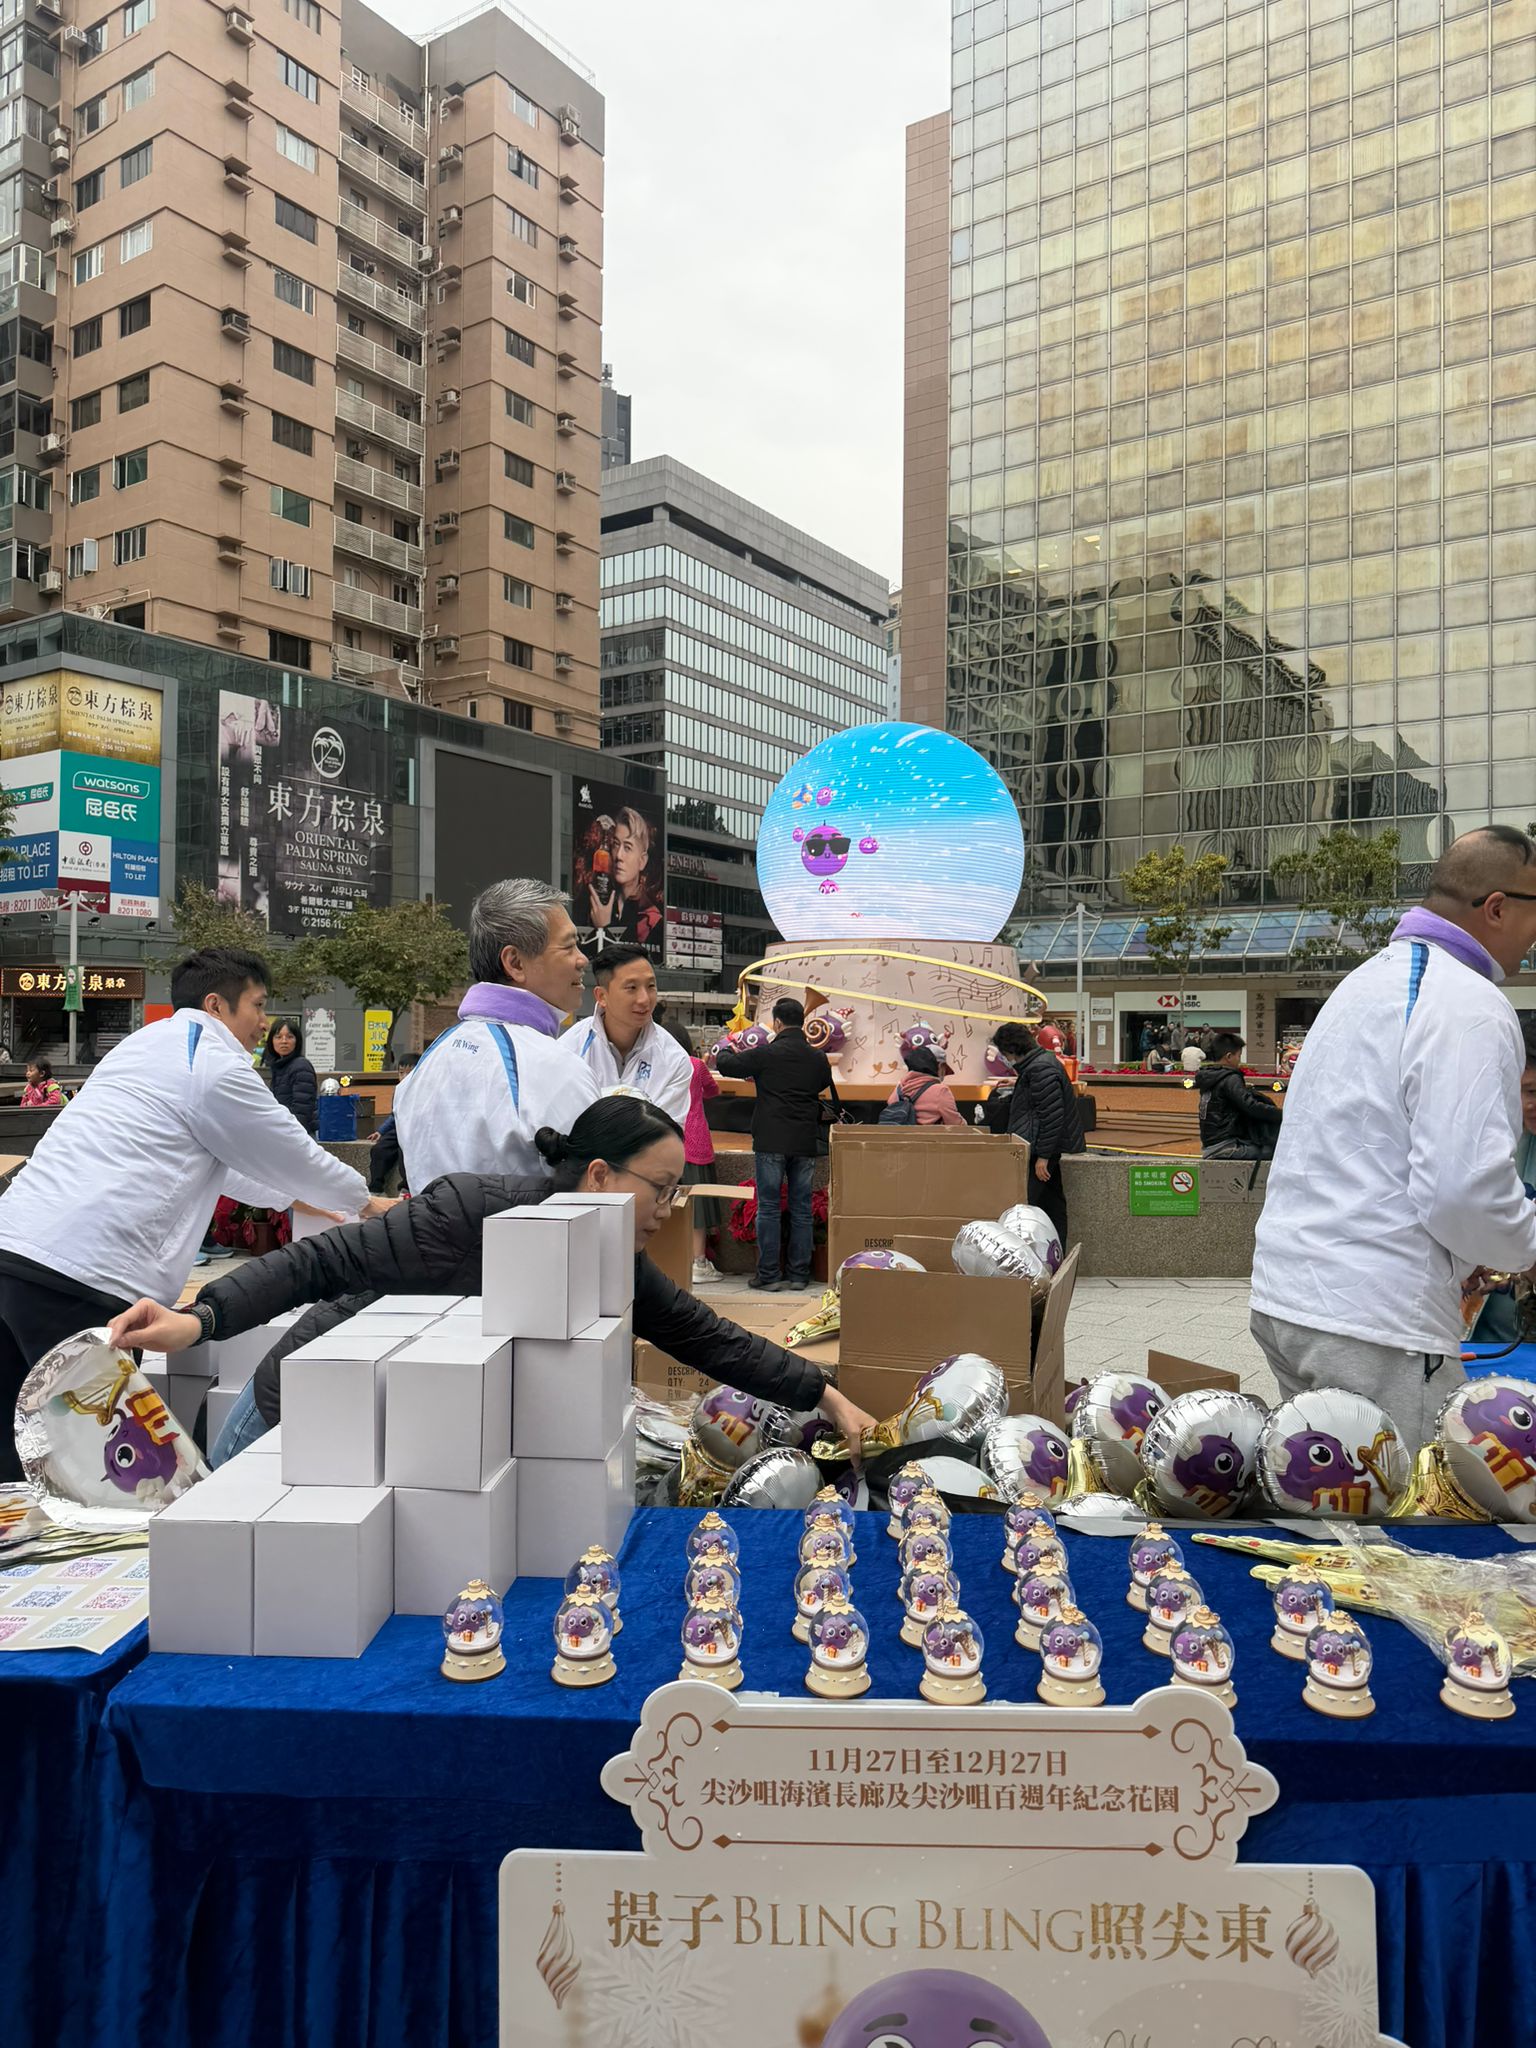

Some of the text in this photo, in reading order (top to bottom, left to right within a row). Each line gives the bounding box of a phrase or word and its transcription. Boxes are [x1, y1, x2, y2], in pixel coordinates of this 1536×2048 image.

[14, 684, 58, 713] 東方棕泉
[84, 689, 153, 721] 東方棕泉
[30, 786, 49, 800] 屈臣氏
[84, 776, 140, 794] watsons
[85, 797, 138, 822] 屈臣氏
[267, 782, 385, 836] 東方棕泉
[20, 841, 51, 859] PLACE
[295, 830, 359, 852] ORIENTAL
[112, 852, 158, 864] HILTON PLACE
[285, 843, 368, 866] PALM SPRING
[17, 866, 30, 880] TO
[33, 863, 50, 879] LET
[300, 859, 353, 876] SAUNA SPA
[125, 873, 146, 881] TO LET
[285, 881, 305, 890] サウナ
[331, 886, 353, 896] 사우나
[353, 889, 368, 899] 스파
[14, 899, 31, 912] 8201
[34, 897, 51, 910] 1080
[117, 906, 152, 916] 8201 1080
[288, 905, 300, 914] 3/F
[301, 906, 330, 918] HILTON
[311, 917, 331, 928] 2156
[36, 972, 126, 992] 東方泉桑拿
[864, 1238, 894, 1248] DESCRIP
[698, 1378, 710, 1387] 24
[808, 1746, 1067, 1777] 11月27日至12月27日
[701, 1778, 1180, 1814] 尖沙咀海濱長廊及尖沙咀百週年紀念花園
